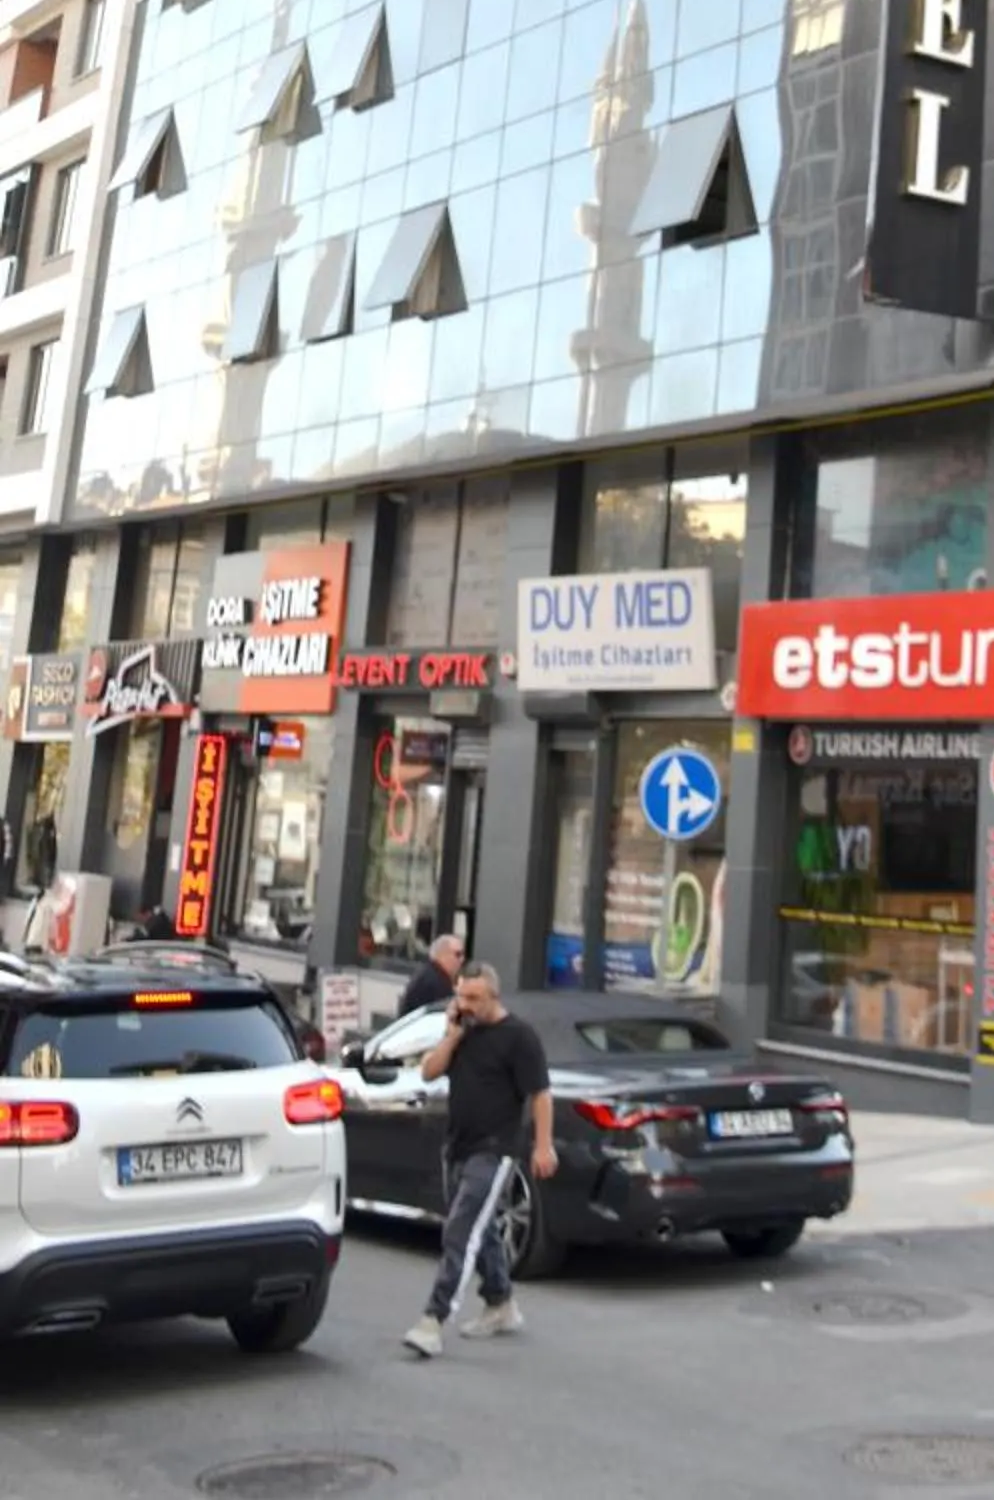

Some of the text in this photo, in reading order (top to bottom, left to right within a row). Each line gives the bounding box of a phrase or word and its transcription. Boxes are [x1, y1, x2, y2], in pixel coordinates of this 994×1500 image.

[206, 597, 245, 628] DORA
[530, 580, 693, 632] DUY MED
[533, 641, 693, 671] İşitme Cihazları
[813, 730, 981, 759] TURKISH AIRLINE
[132, 1141, 238, 1174] 34 EPC 847
